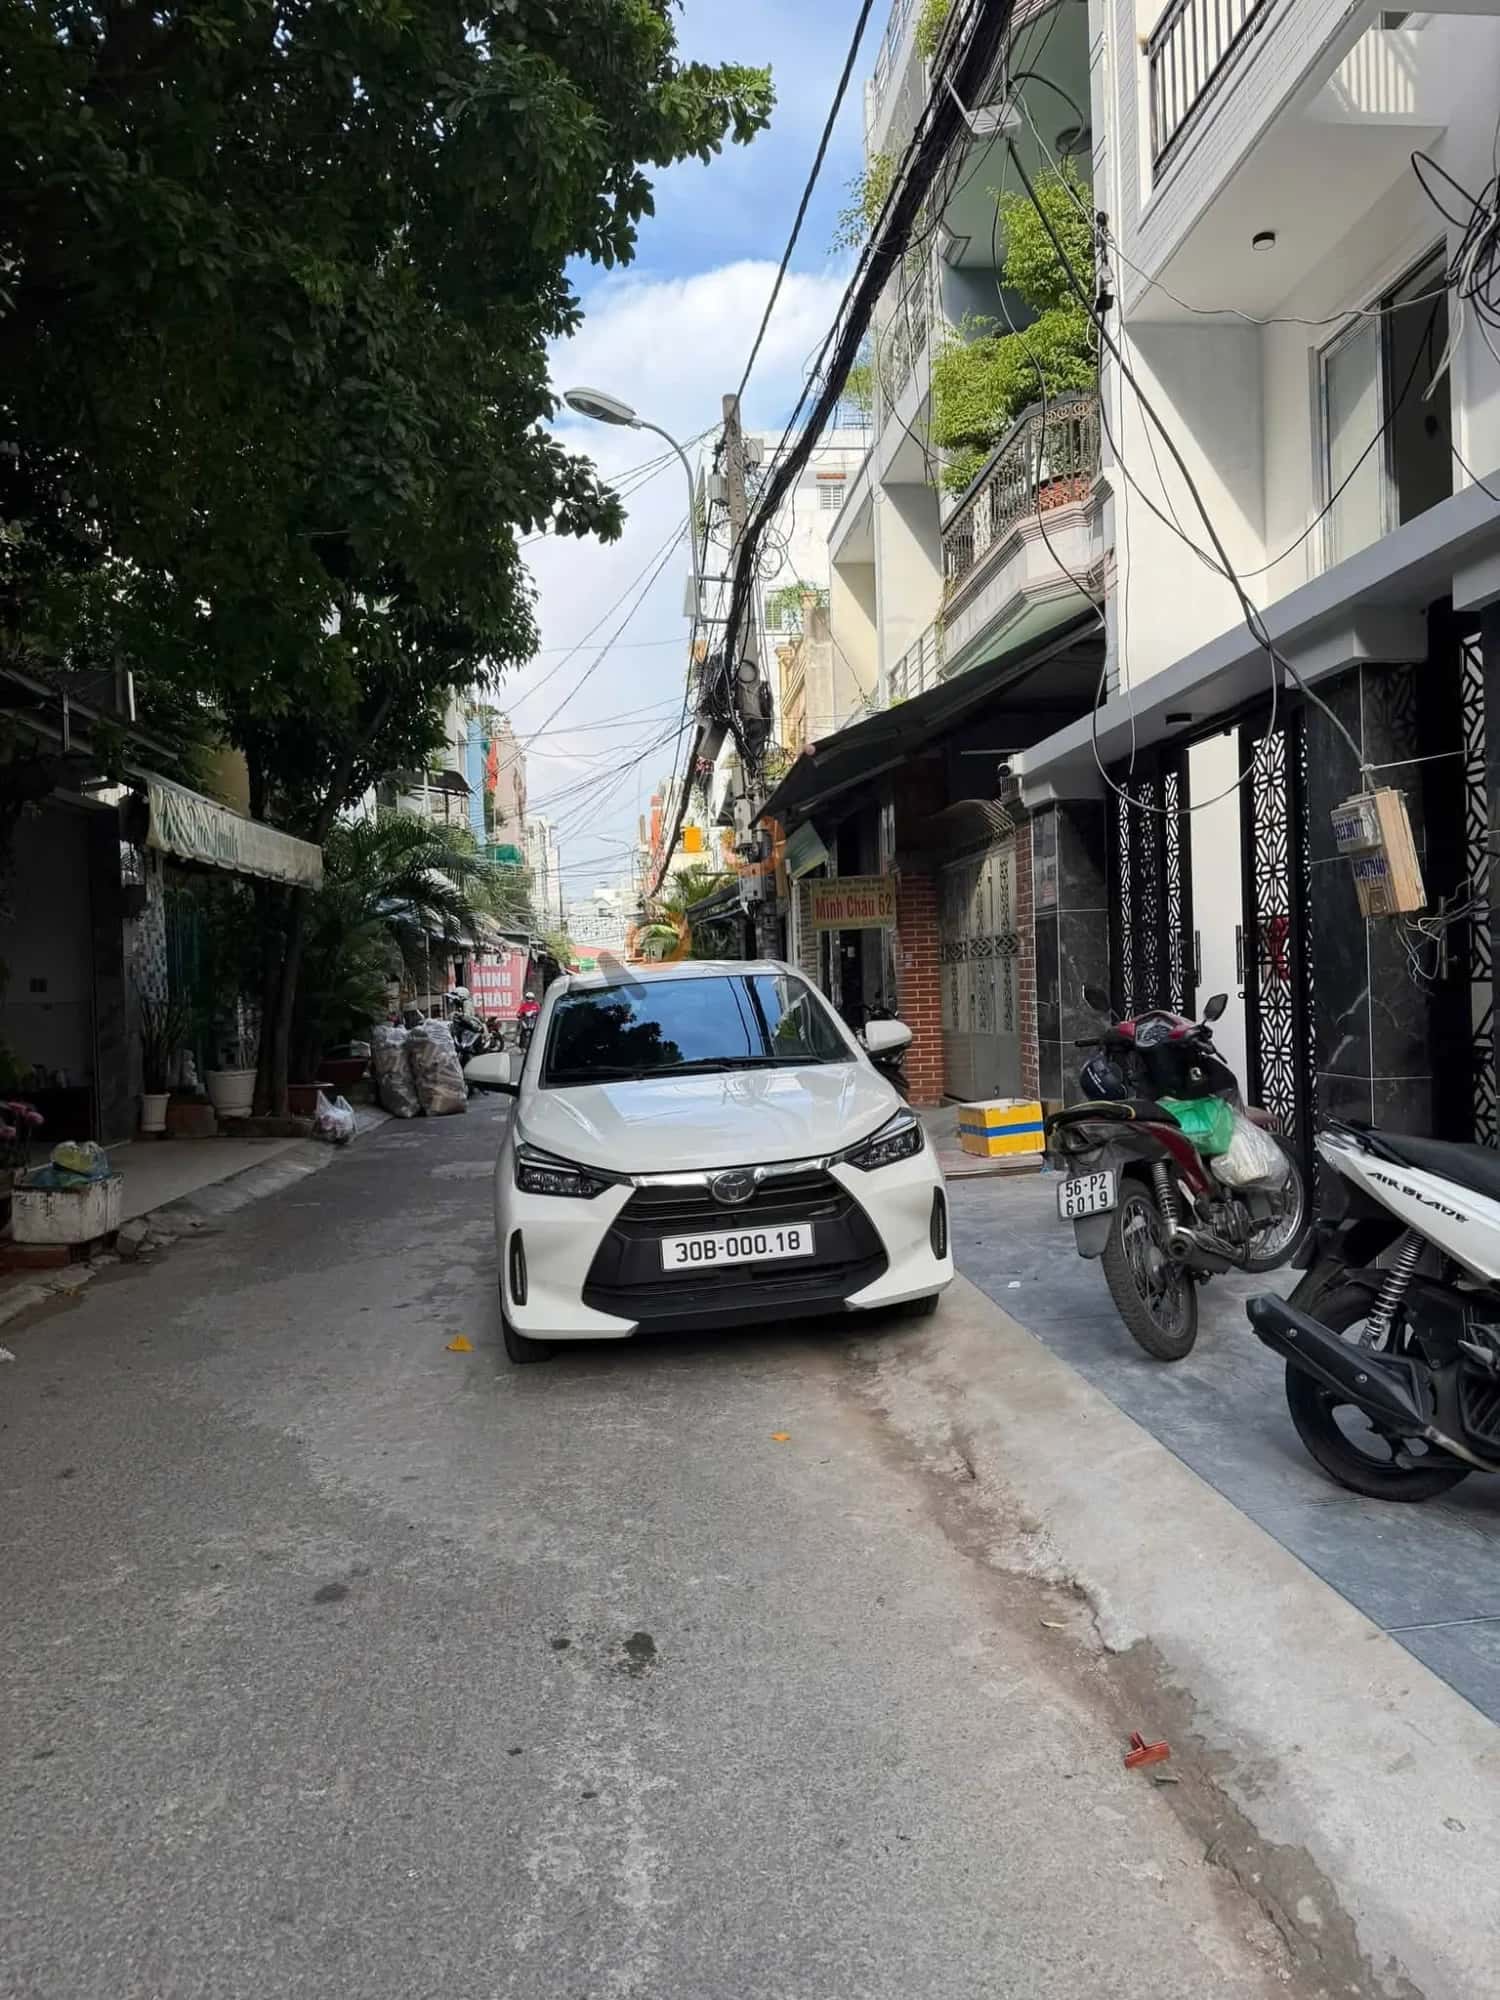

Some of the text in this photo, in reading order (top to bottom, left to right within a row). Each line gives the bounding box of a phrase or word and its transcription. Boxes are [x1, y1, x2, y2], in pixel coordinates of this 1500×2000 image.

[815, 896, 844, 920] Minh
[878, 893, 893, 916] 62
[1065, 1173, 1107, 1198] 56-P2
[1066, 1191, 1108, 1216] 6019
[674, 1231, 801, 1263] 30B-000.18
